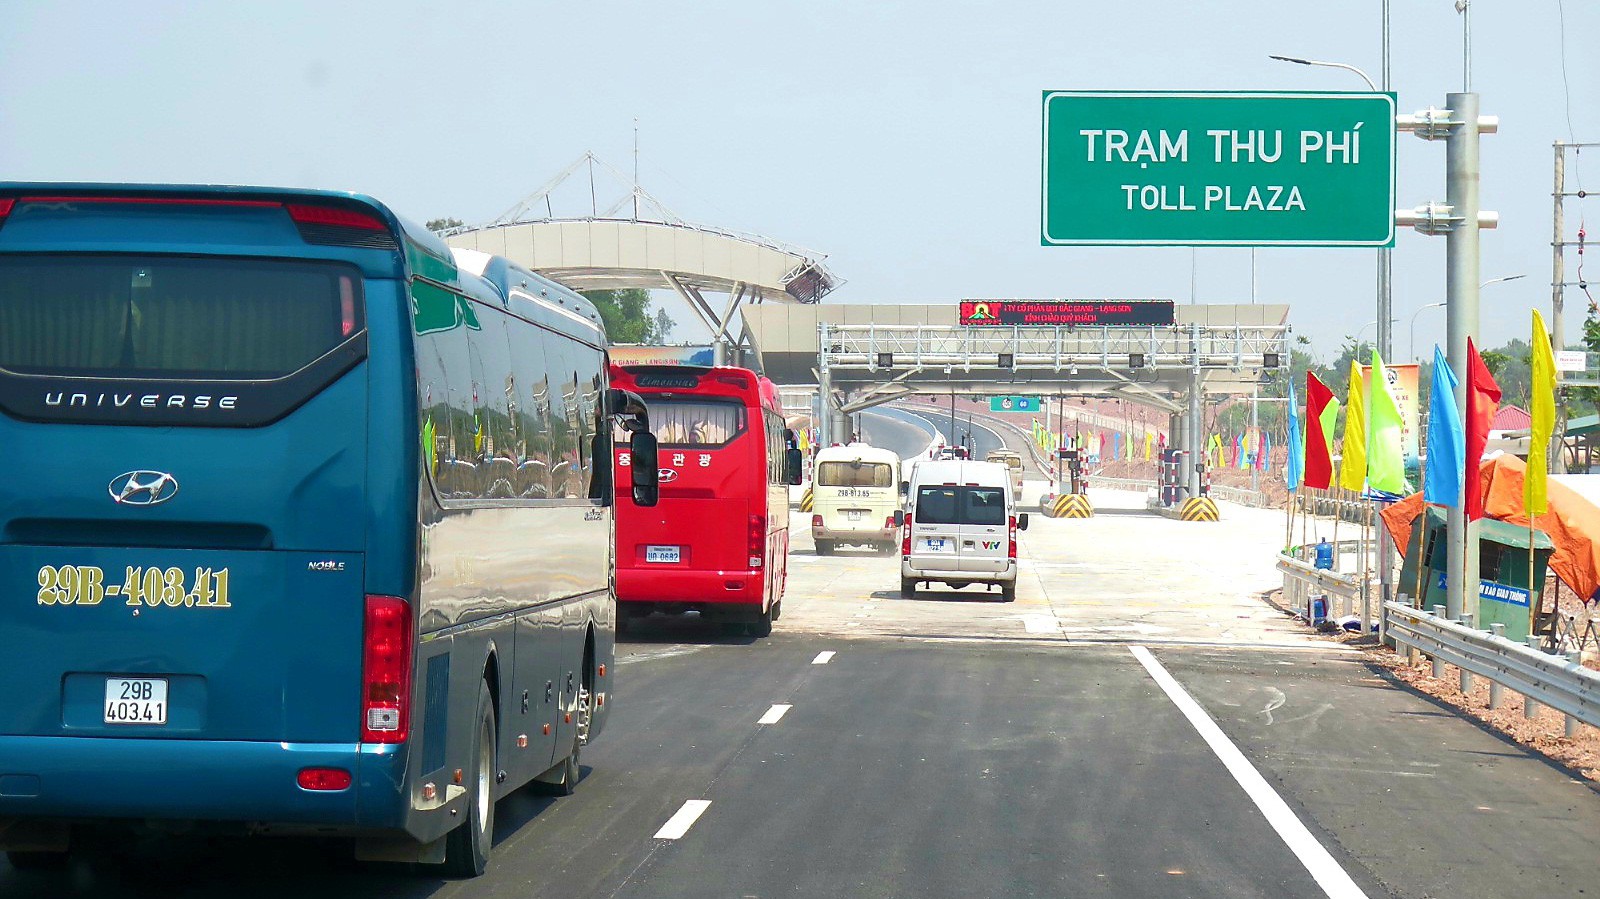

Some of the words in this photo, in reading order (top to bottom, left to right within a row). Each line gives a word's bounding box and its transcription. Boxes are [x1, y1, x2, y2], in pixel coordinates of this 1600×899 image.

[1079, 129, 1188, 169] TRẠM
[1206, 130, 1282, 163] THU
[1300, 121, 1364, 164] PHÍ
[1121, 184, 1196, 211] TOLL
[1204, 185, 1306, 212] PLAZA
[45, 391, 238, 409] UNIVERSE
[982, 541, 1001, 550] VTV
[307, 560, 345, 571] NOBLE
[36, 564, 232, 608] 29B-403.41
[1496, 587, 1510, 600] GIAO
[119, 681, 153, 701] 29B
[106, 701, 164, 723] 403.41
